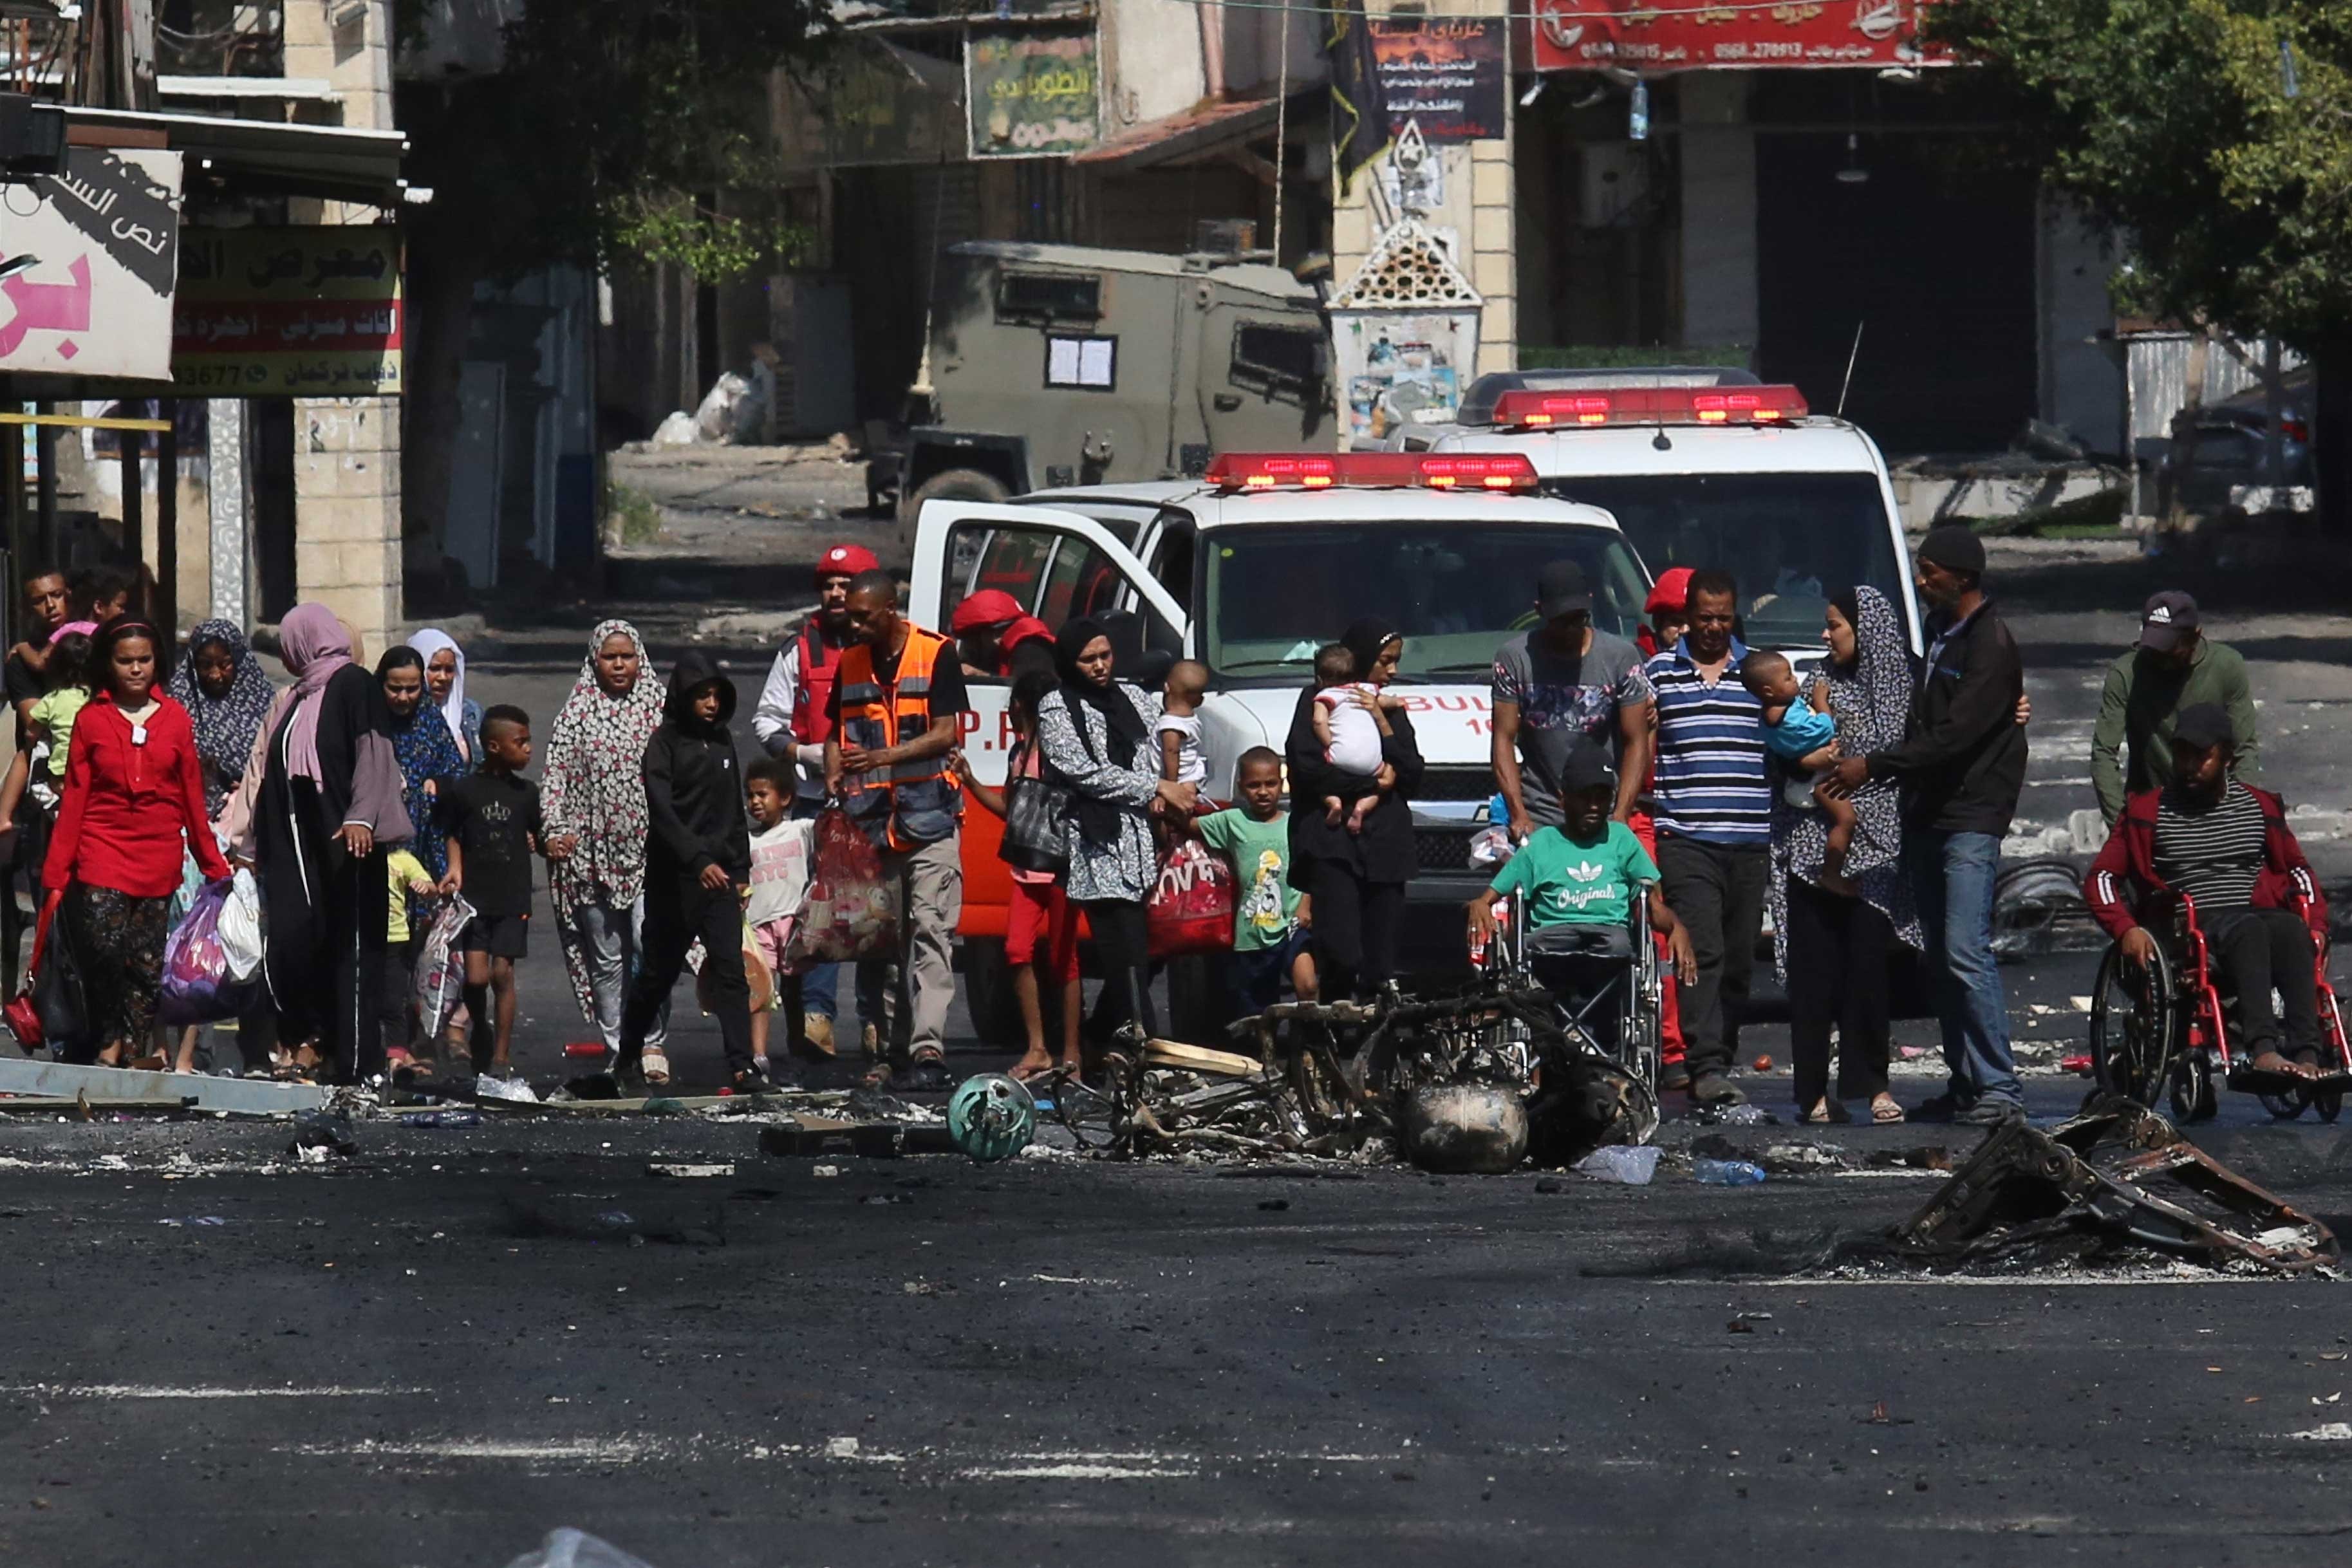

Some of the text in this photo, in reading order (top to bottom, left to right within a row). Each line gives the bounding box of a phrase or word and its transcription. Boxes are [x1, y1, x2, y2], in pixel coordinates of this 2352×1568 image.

[111, 217, 167, 255] نص
[247, 237, 387, 288] معرض
[1558, 882, 1616, 909] Originals
